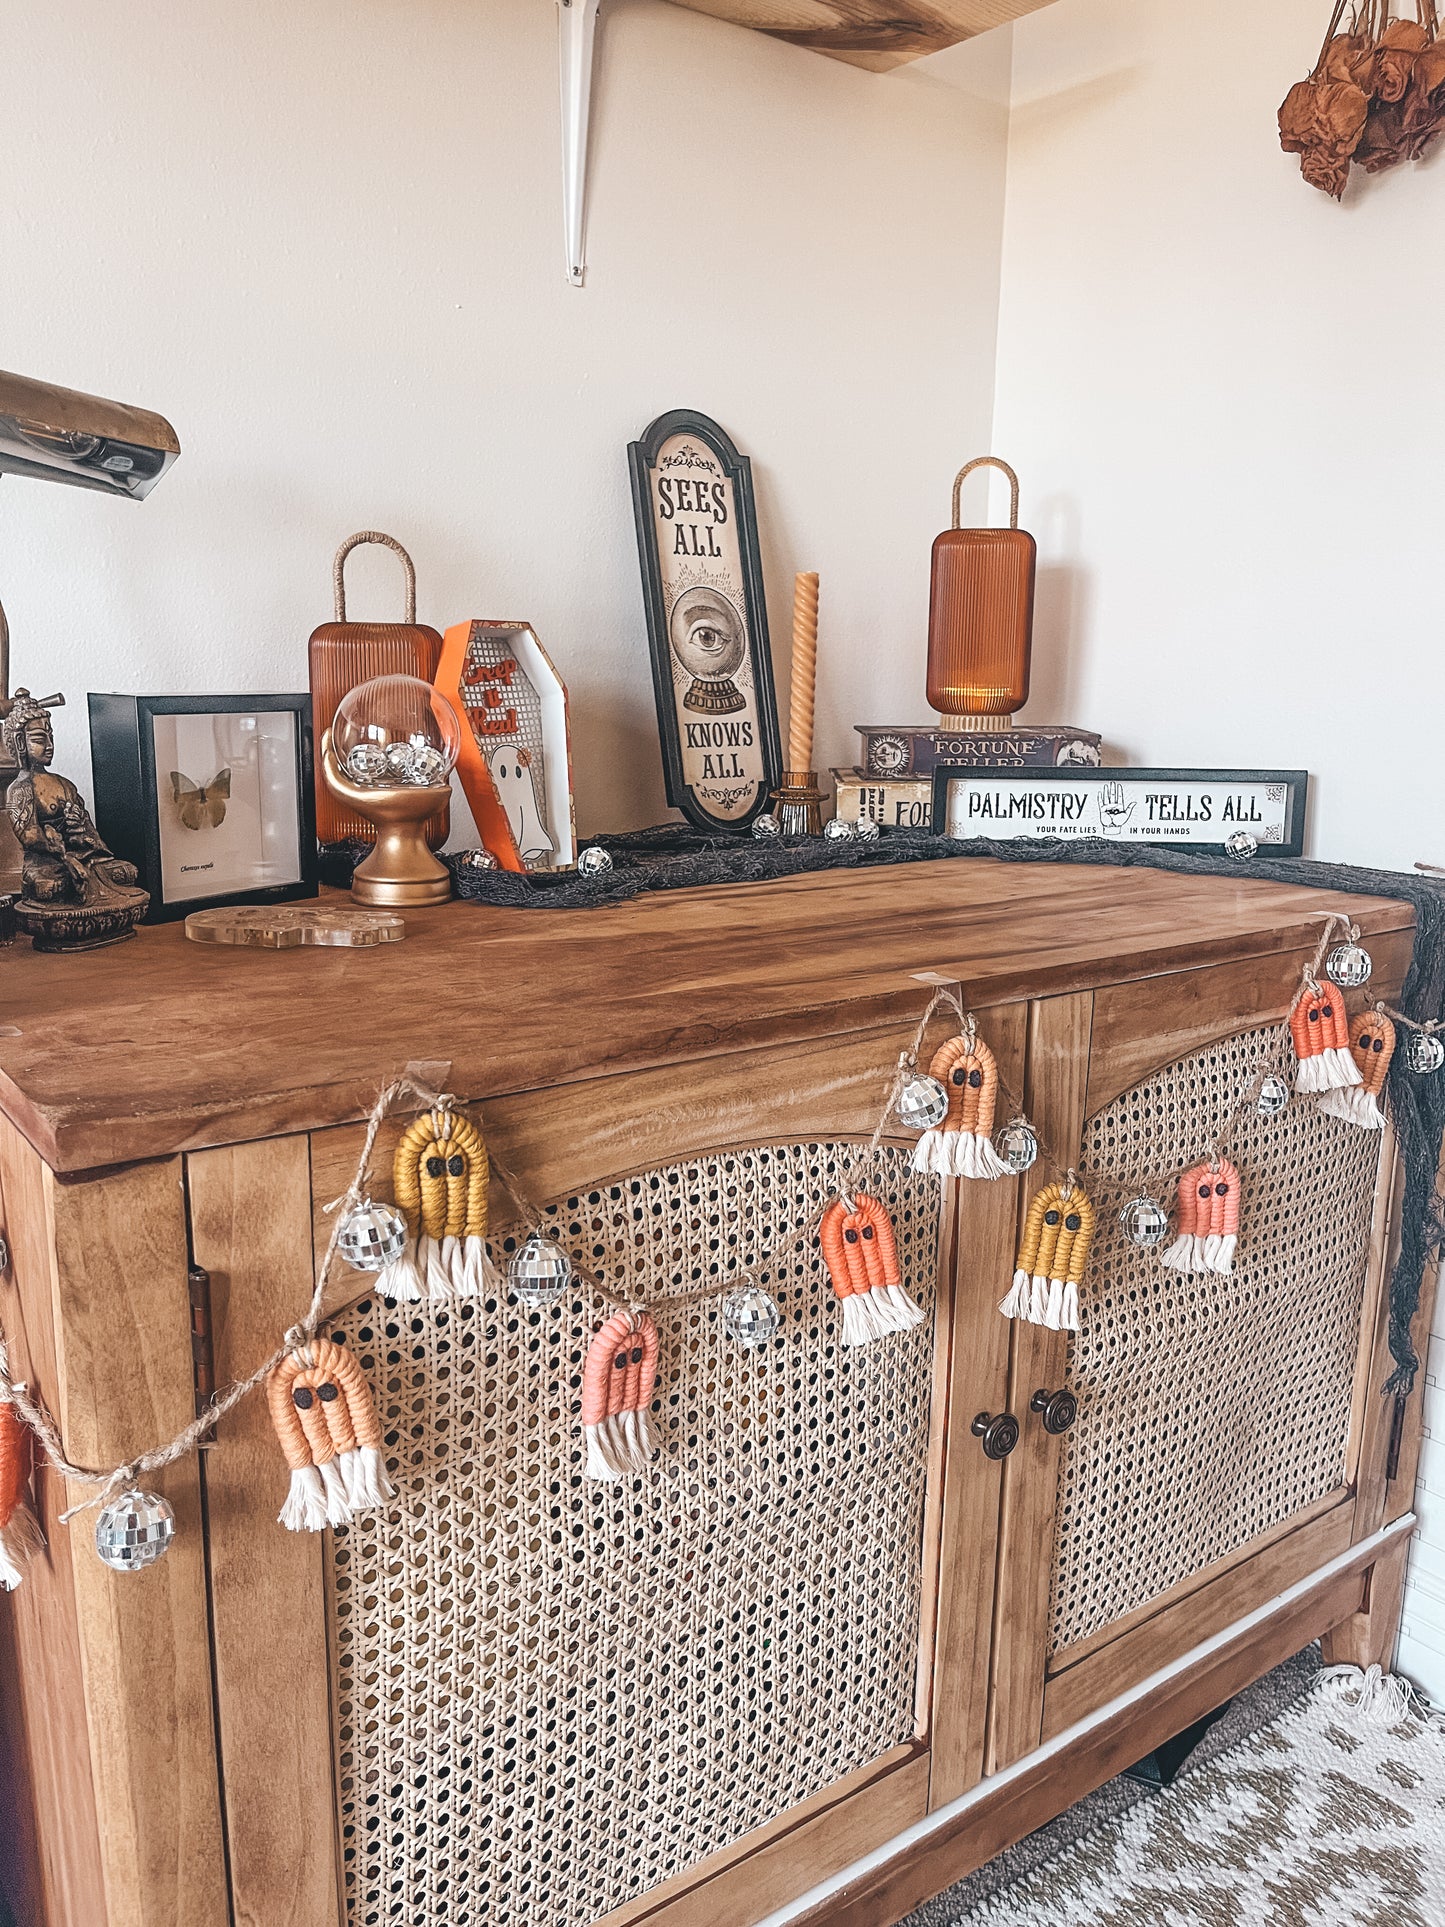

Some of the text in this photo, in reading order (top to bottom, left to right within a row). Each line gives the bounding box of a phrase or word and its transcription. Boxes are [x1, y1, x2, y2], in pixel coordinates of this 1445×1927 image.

[658, 477, 728, 524] SEES
[673, 523, 722, 557] ALL
[468, 706, 519, 736] Real
[684, 721, 754, 748] KNOWS
[934, 739, 1037, 757] FORTUNE
[702, 753, 745, 779] ALL
[968, 791, 1262, 822] PALMISTRY TELLS ALL
[1036, 825, 1191, 835] YOUR FATE LIES IN YOUR HANDS
